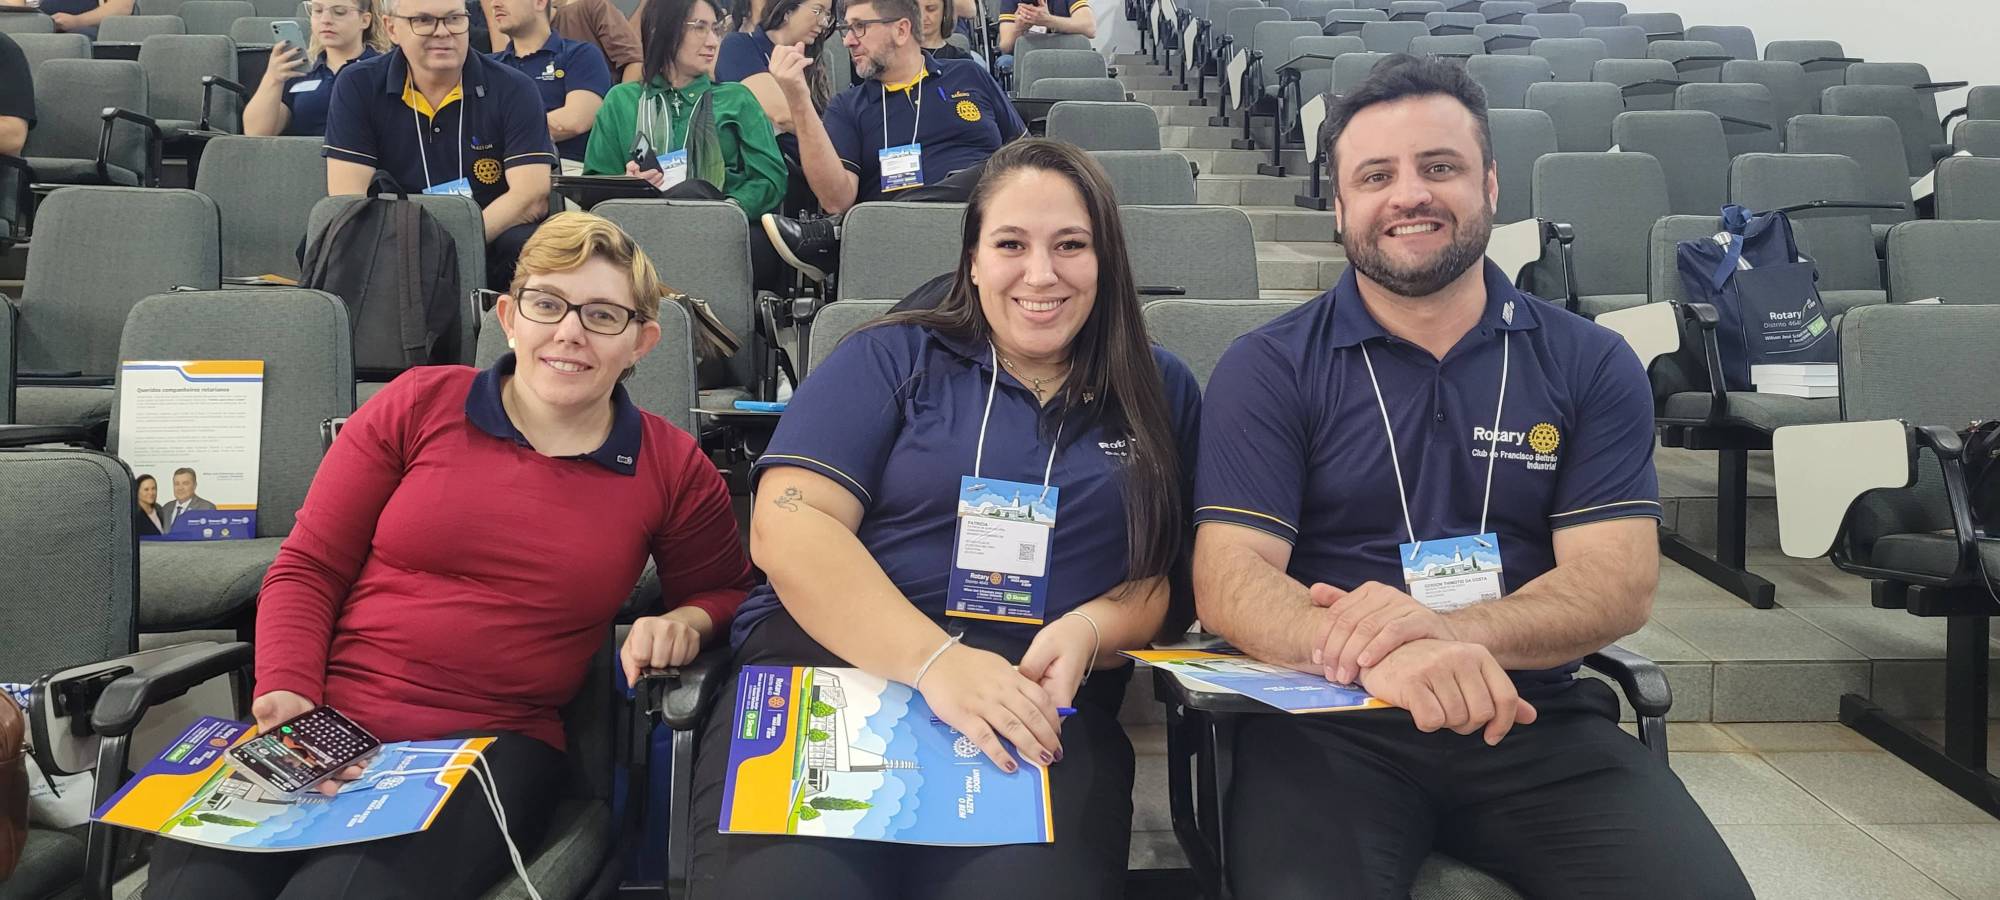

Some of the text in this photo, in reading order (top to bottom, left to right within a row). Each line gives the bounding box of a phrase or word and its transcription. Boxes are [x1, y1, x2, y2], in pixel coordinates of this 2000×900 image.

[1769, 311, 1802, 320] Rotary
[1473, 426, 1525, 446] Rotary
[1471, 448, 1488, 458] Club
[1500, 450, 1534, 461] Francisco
[1526, 461, 1557, 471] Industrial
[969, 572, 990, 581] Rotary
[773, 677, 784, 696] Rotary
[972, 768, 981, 793] UNIDOS
[965, 775, 974, 815] PARA FAZER
[958, 803, 967, 819] BEM
